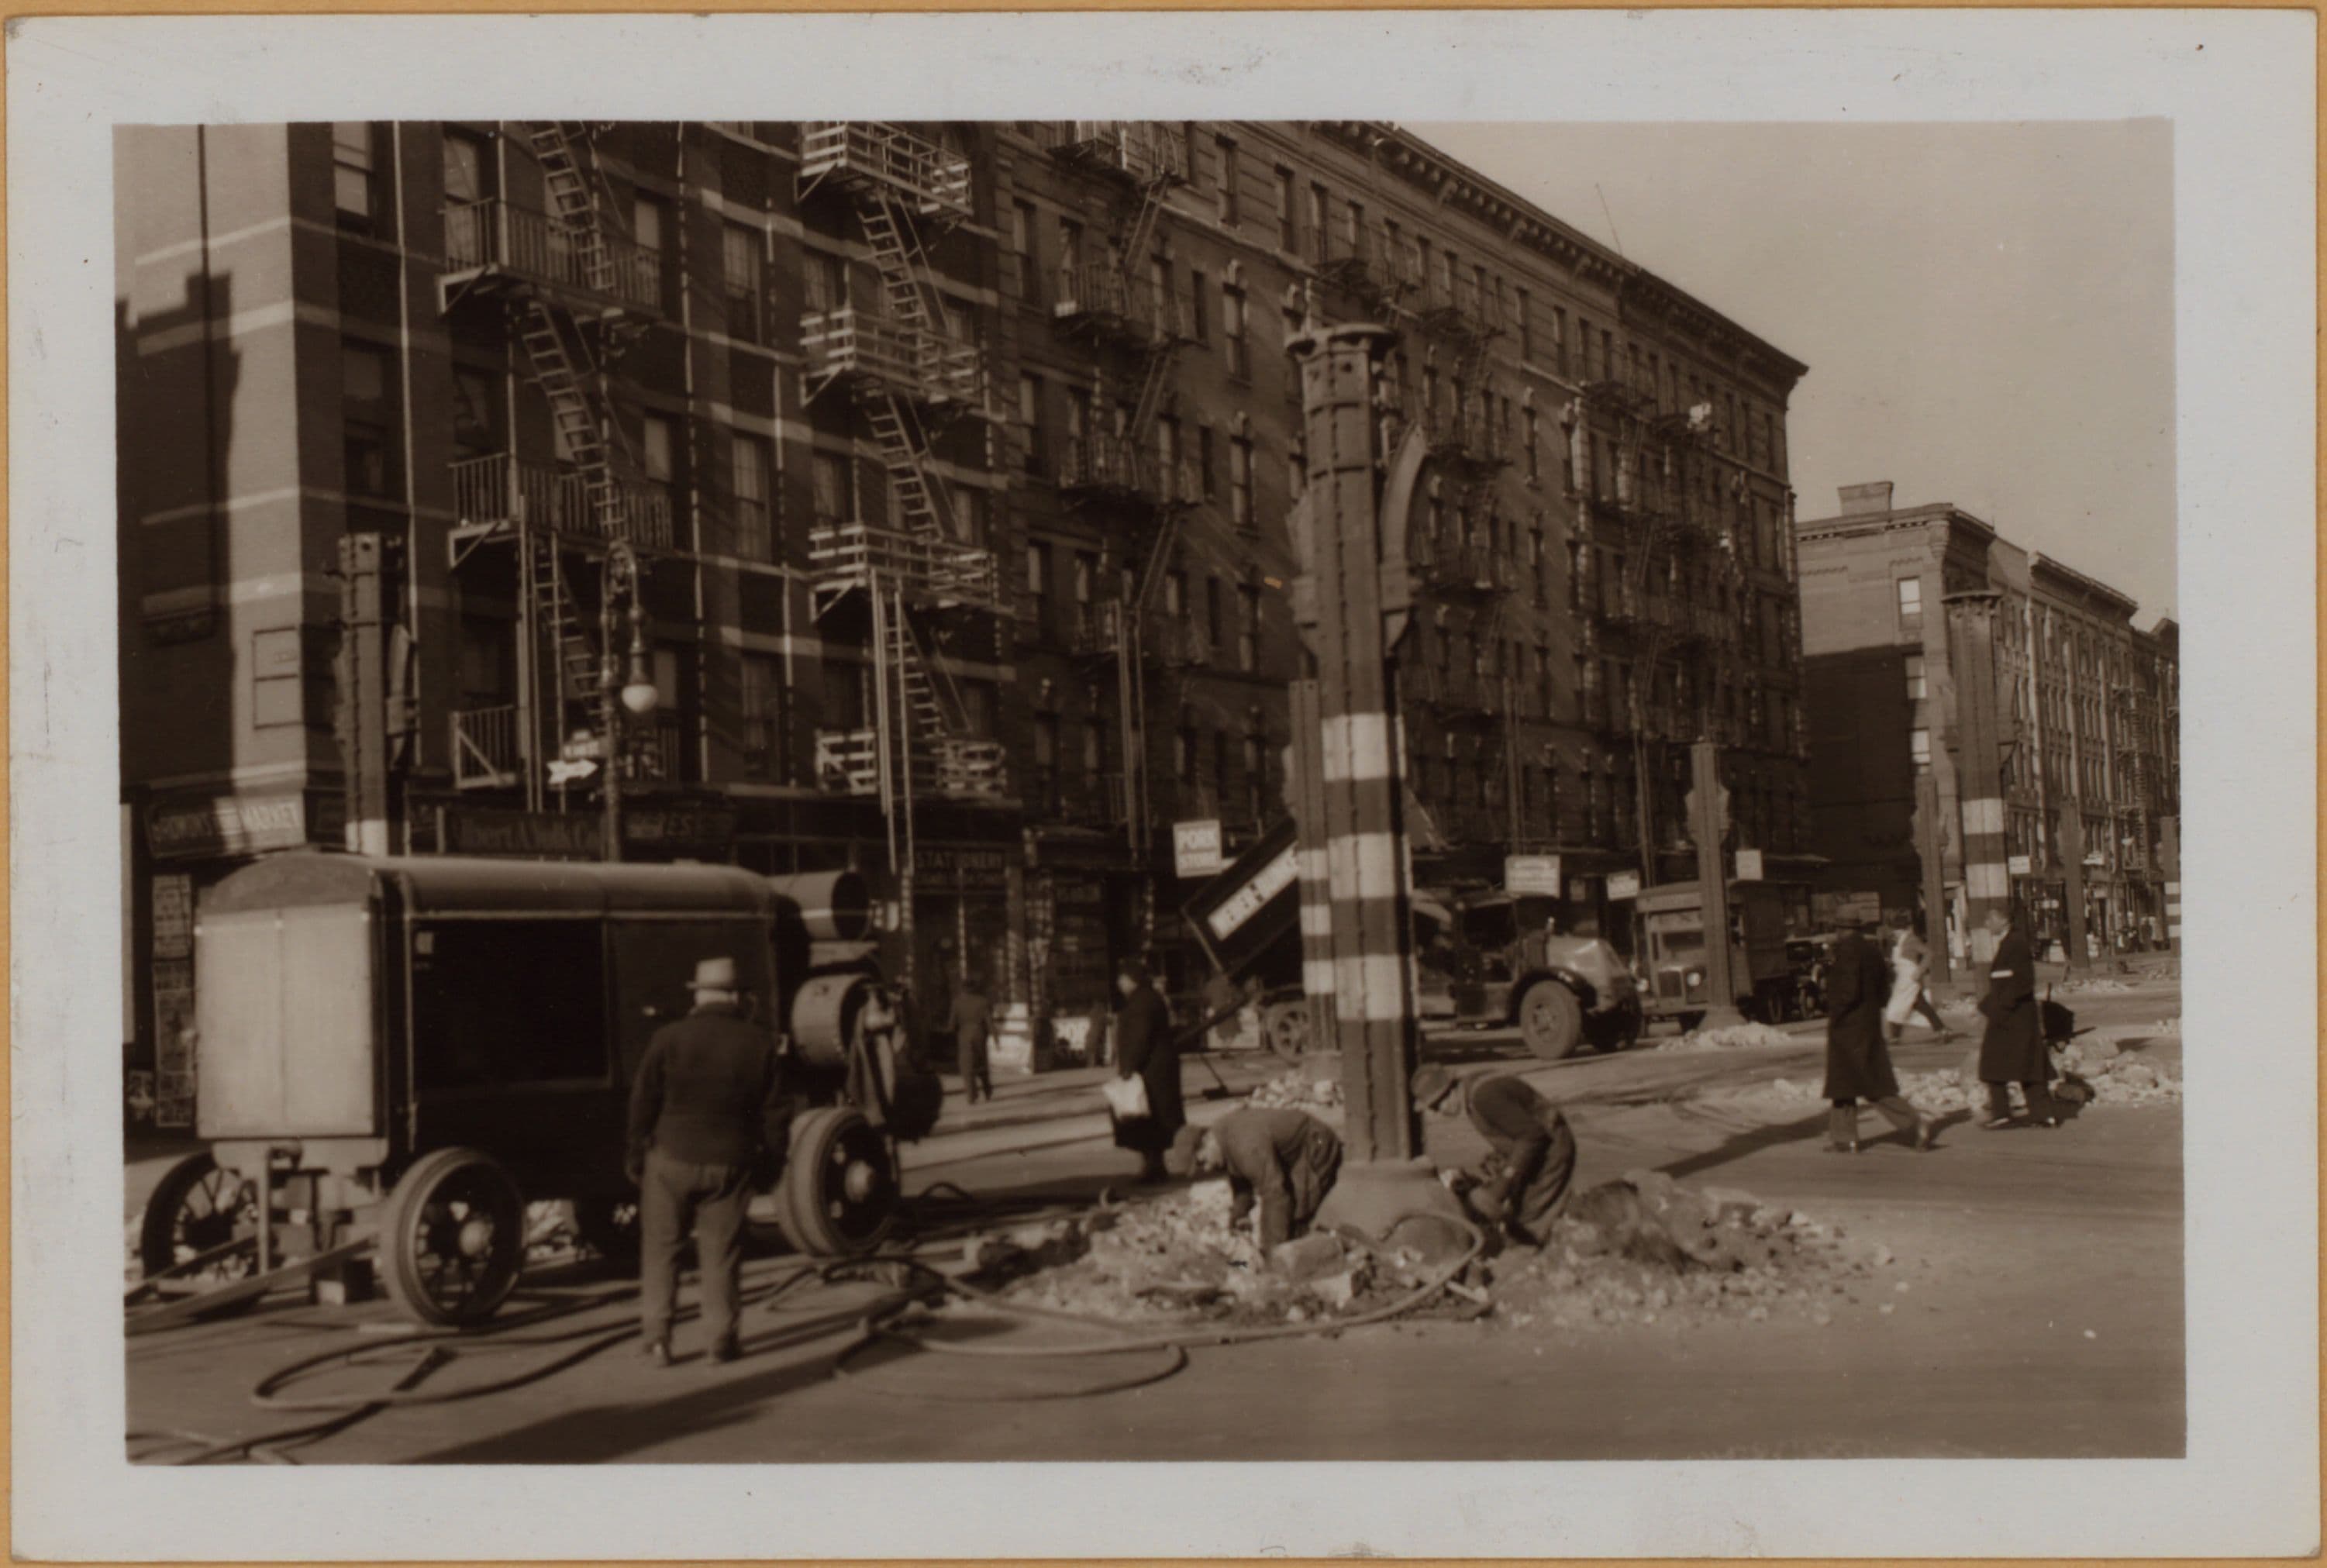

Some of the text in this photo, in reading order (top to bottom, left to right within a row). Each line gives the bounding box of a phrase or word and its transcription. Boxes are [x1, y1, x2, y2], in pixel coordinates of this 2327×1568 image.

[240, 801, 301, 833] MARKET
[1177, 829, 1215, 851] PORK
[915, 850, 1004, 870] STATONERY
[1177, 851, 1216, 869] STORE
